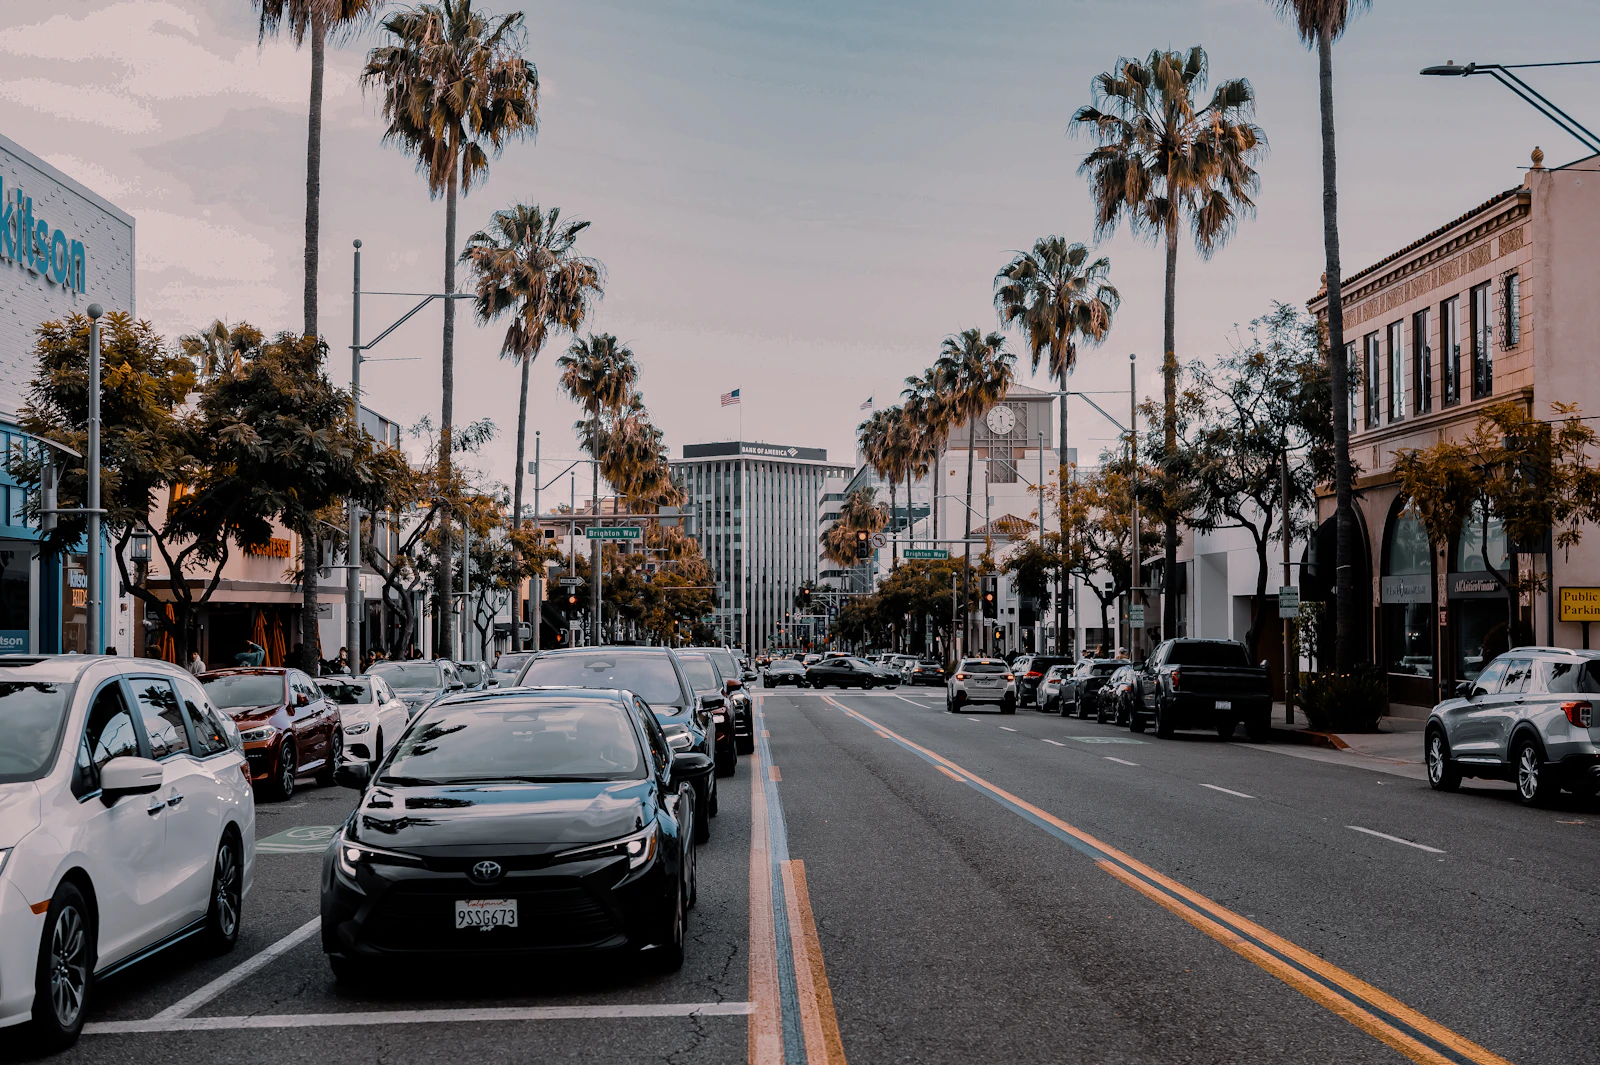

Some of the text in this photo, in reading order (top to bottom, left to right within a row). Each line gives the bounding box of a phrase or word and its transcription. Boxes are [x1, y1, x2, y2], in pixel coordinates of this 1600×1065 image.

[0, 175, 86, 294] kitson
[742, 446, 756, 454] BANK
[589, 530, 638, 538] Brighton Way
[70, 569, 88, 588] kitso
[1564, 591, 1598, 602] Public
[1563, 604, 1600, 615] Parkin
[458, 909, 515, 925] 9SSG673
